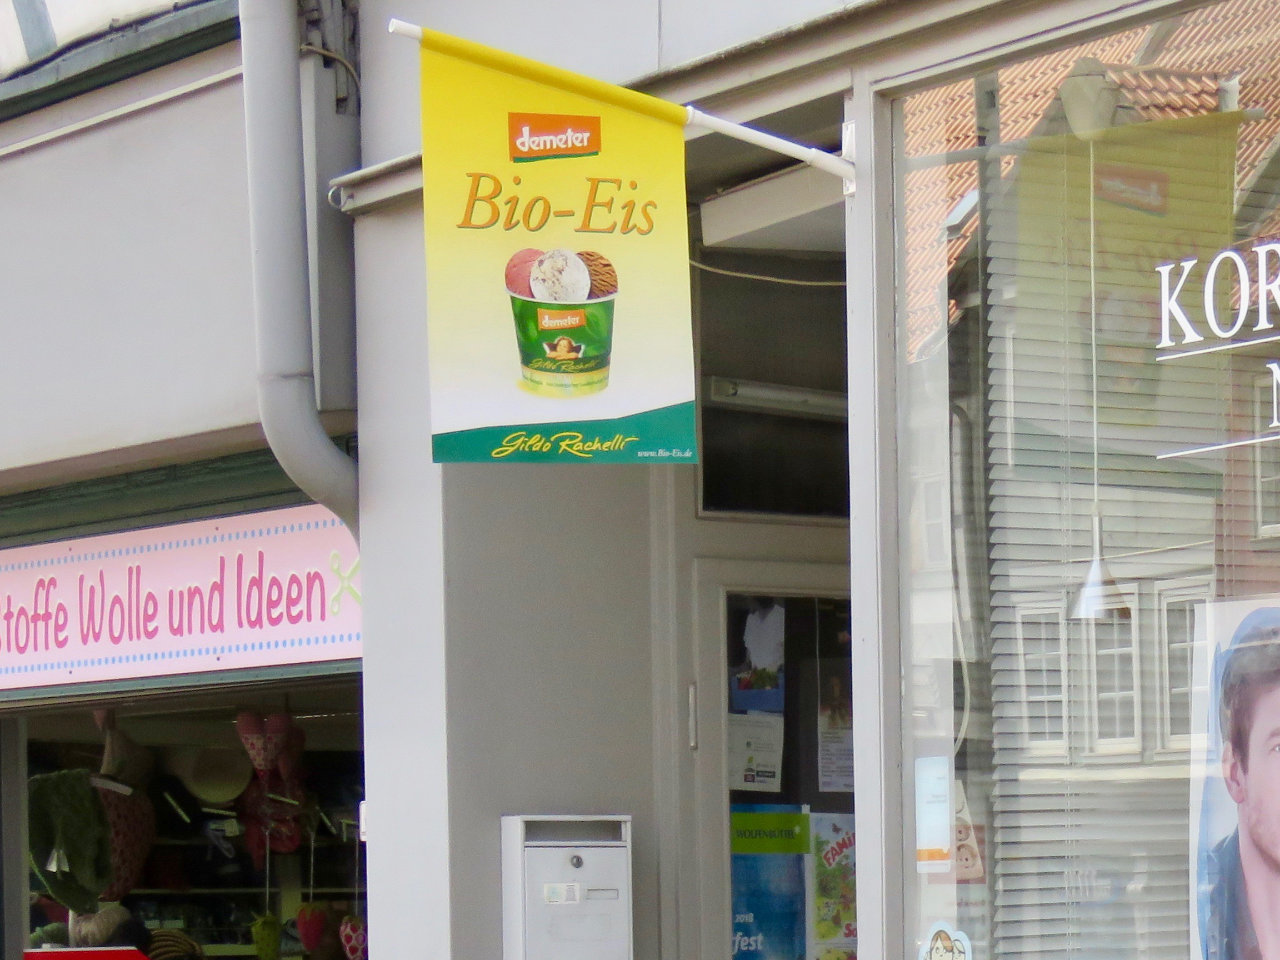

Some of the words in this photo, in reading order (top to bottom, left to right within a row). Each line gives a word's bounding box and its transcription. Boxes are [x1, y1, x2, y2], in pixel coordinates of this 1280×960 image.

[515, 126, 591, 152] demeter
[456, 171, 658, 236] Bio-Eis
[541, 314, 580, 327] demeter
[491, 431, 551, 458] Gildo
[551, 431, 640, 458] Rachelli
[0, 577, 69, 655] toffe
[78, 564, 159, 646] Wolle
[168, 555, 225, 637] und
[236, 550, 326, 631] Ideen
